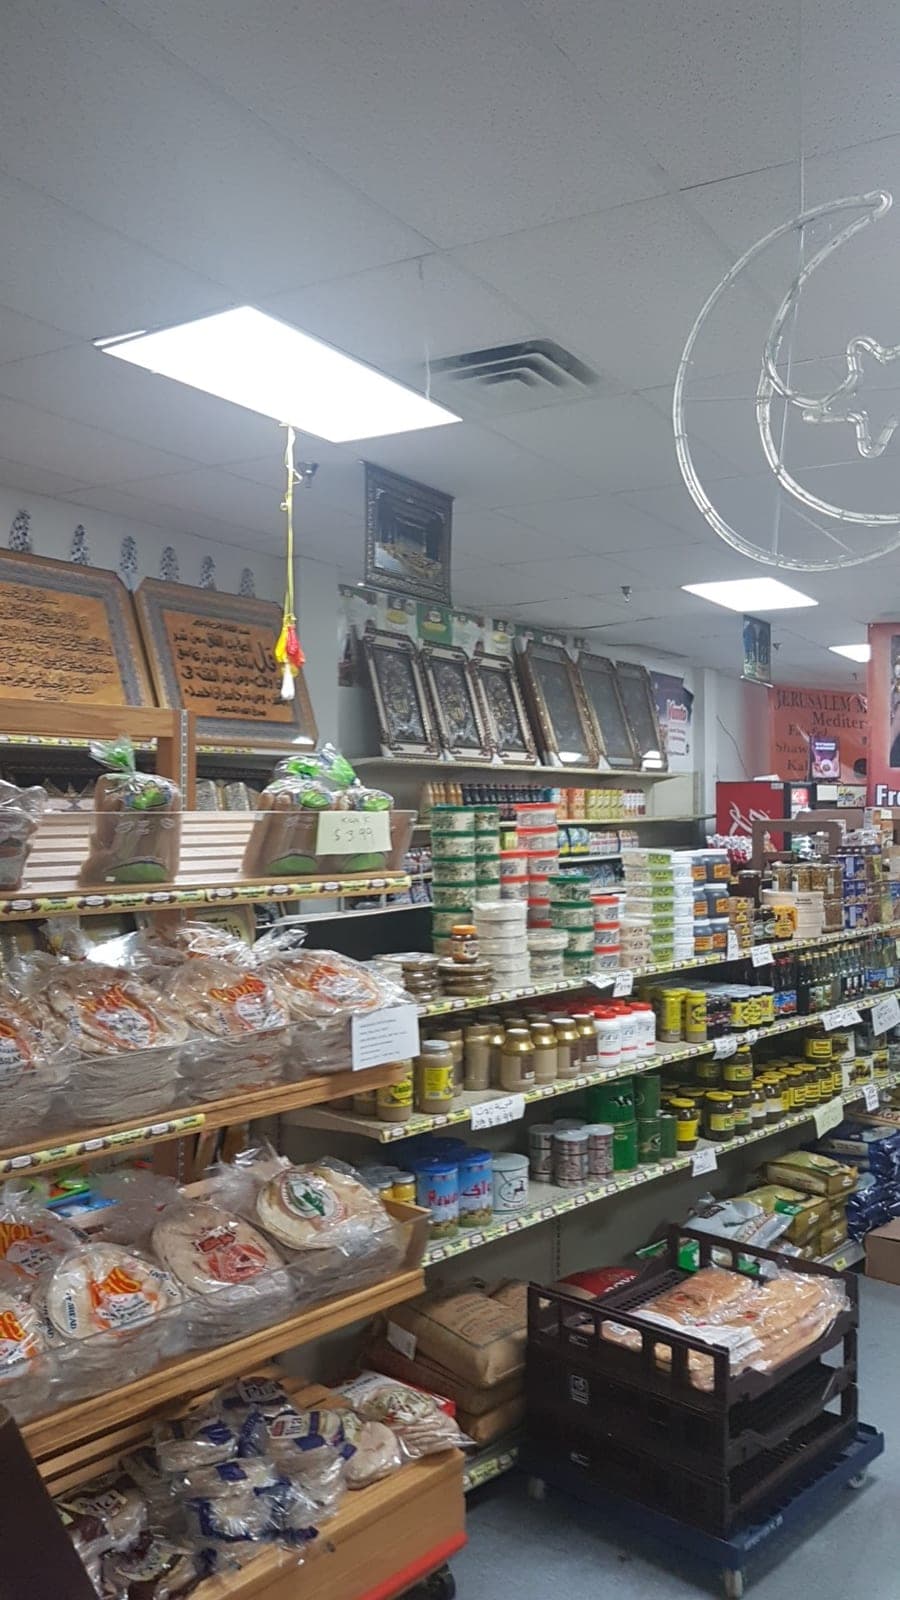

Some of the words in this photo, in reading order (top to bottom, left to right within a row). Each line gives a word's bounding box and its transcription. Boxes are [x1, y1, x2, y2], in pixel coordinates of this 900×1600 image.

[775, 689, 851, 712] JERUSALEM
[812, 711, 868, 730] Mediter
[775, 743, 808, 754] Shaw
